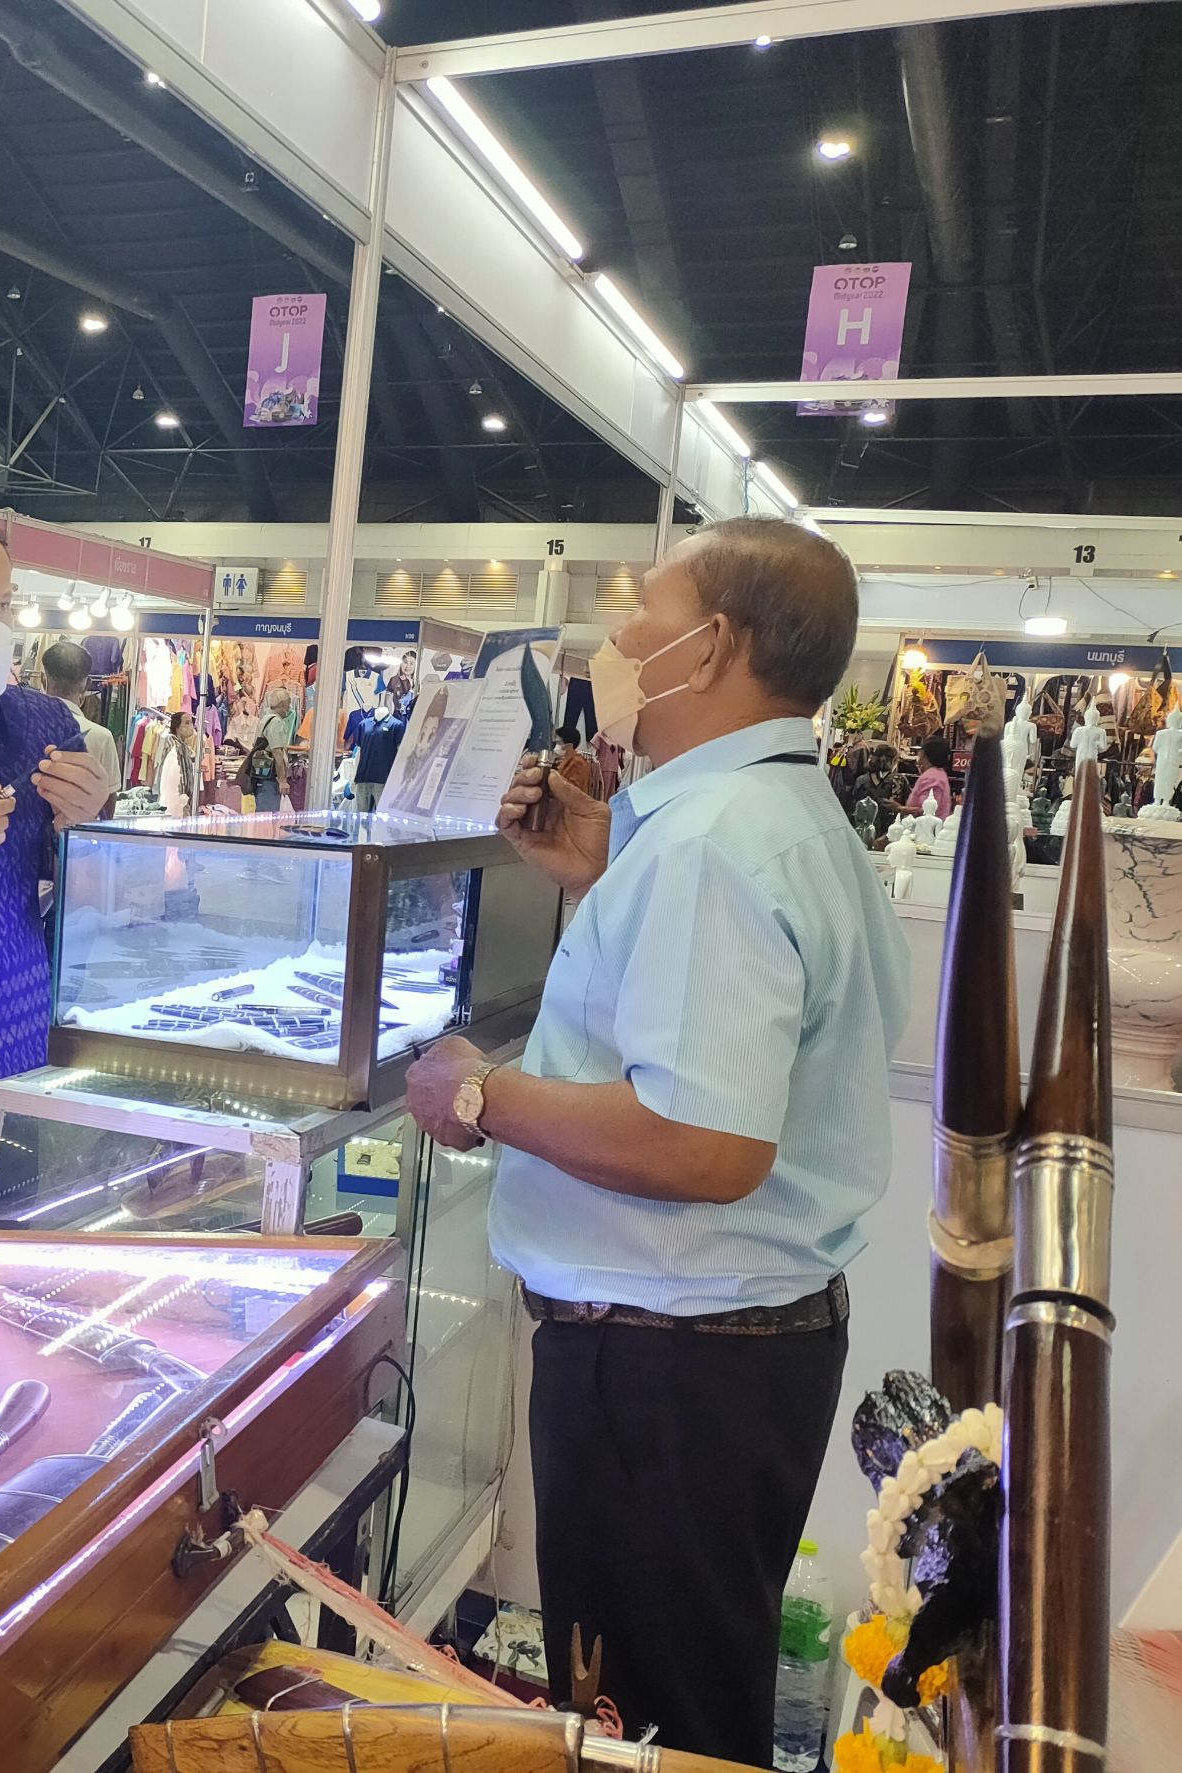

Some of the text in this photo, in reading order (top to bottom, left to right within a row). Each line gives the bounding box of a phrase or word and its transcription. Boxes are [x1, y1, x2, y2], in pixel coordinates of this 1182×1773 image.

[834, 276, 886, 290] OTOP
[269, 304, 308, 318] OTOP
[836, 307, 873, 346] H
[274, 332, 291, 374] J
[139, 537, 152, 548] 17
[547, 539, 565, 556] 15
[1073, 545, 1096, 564] 13
[255, 622, 292, 636] กาญจนบุรี
[1087, 650, 1125, 667] นนทบุรี
